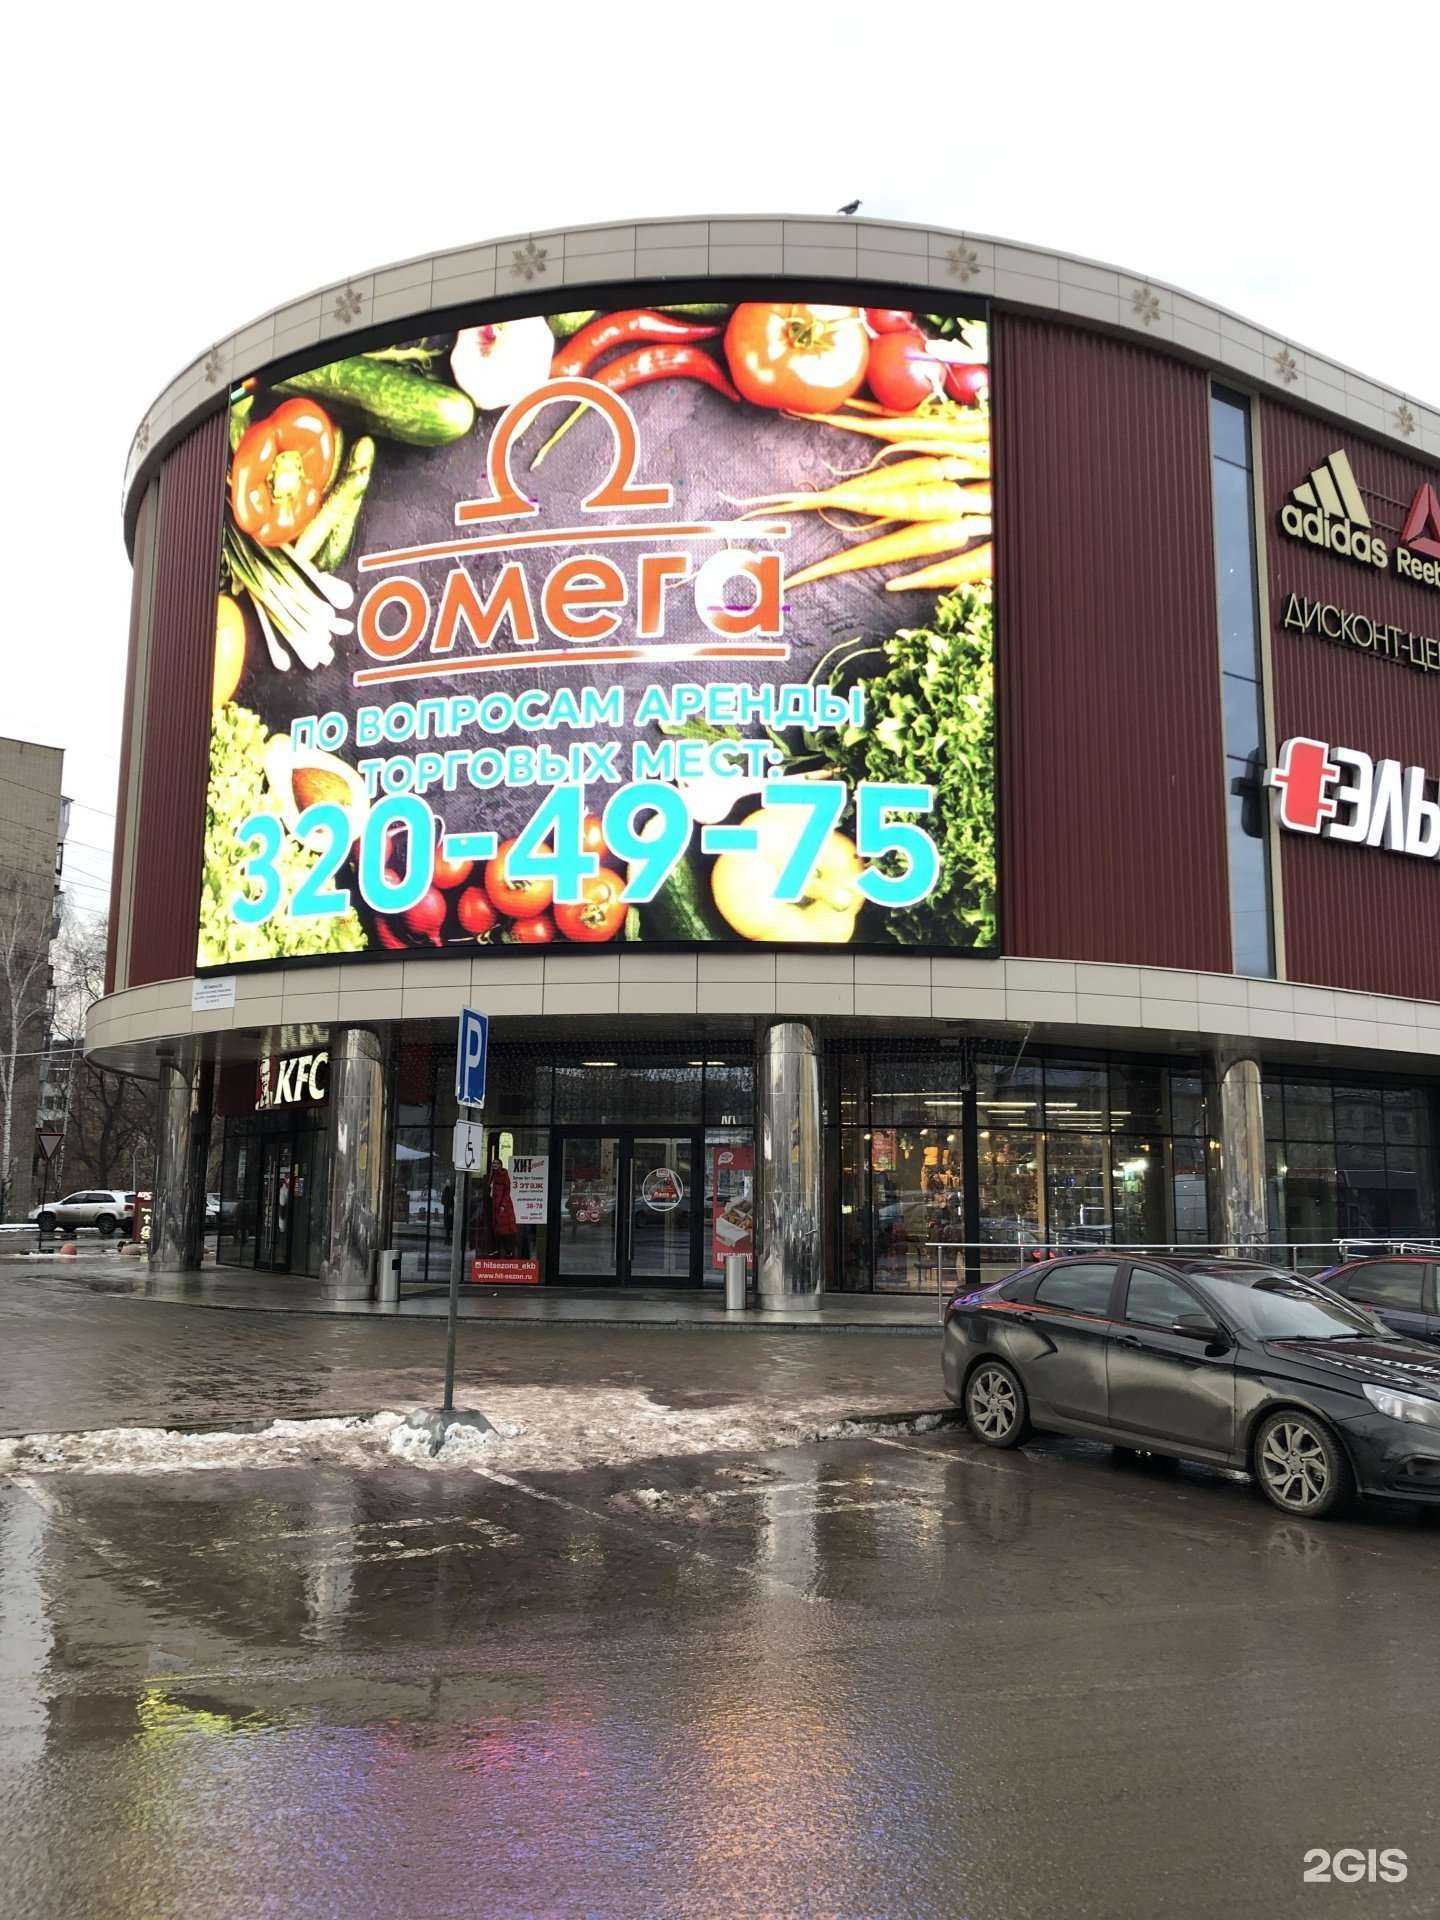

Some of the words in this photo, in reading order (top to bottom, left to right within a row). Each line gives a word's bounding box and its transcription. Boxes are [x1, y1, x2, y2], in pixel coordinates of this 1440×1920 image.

[1281, 504, 1389, 568] adidas
[358, 549, 785, 662] омега
[1284, 592, 1440, 673] ДИСКОНТ-ЦЕ
[290, 712, 348, 753] ПО
[356, 684, 624, 747] ВОПРОСАМ
[637, 683, 866, 730] АРЕНДЫ
[358, 741, 620, 797] ТОРГОВЫХ
[631, 738, 785, 782] МЕСТ:
[231, 781, 940, 925] 320-49-75
[273, 1052, 329, 1105] KFC
[464, 1016, 482, 1100] P
